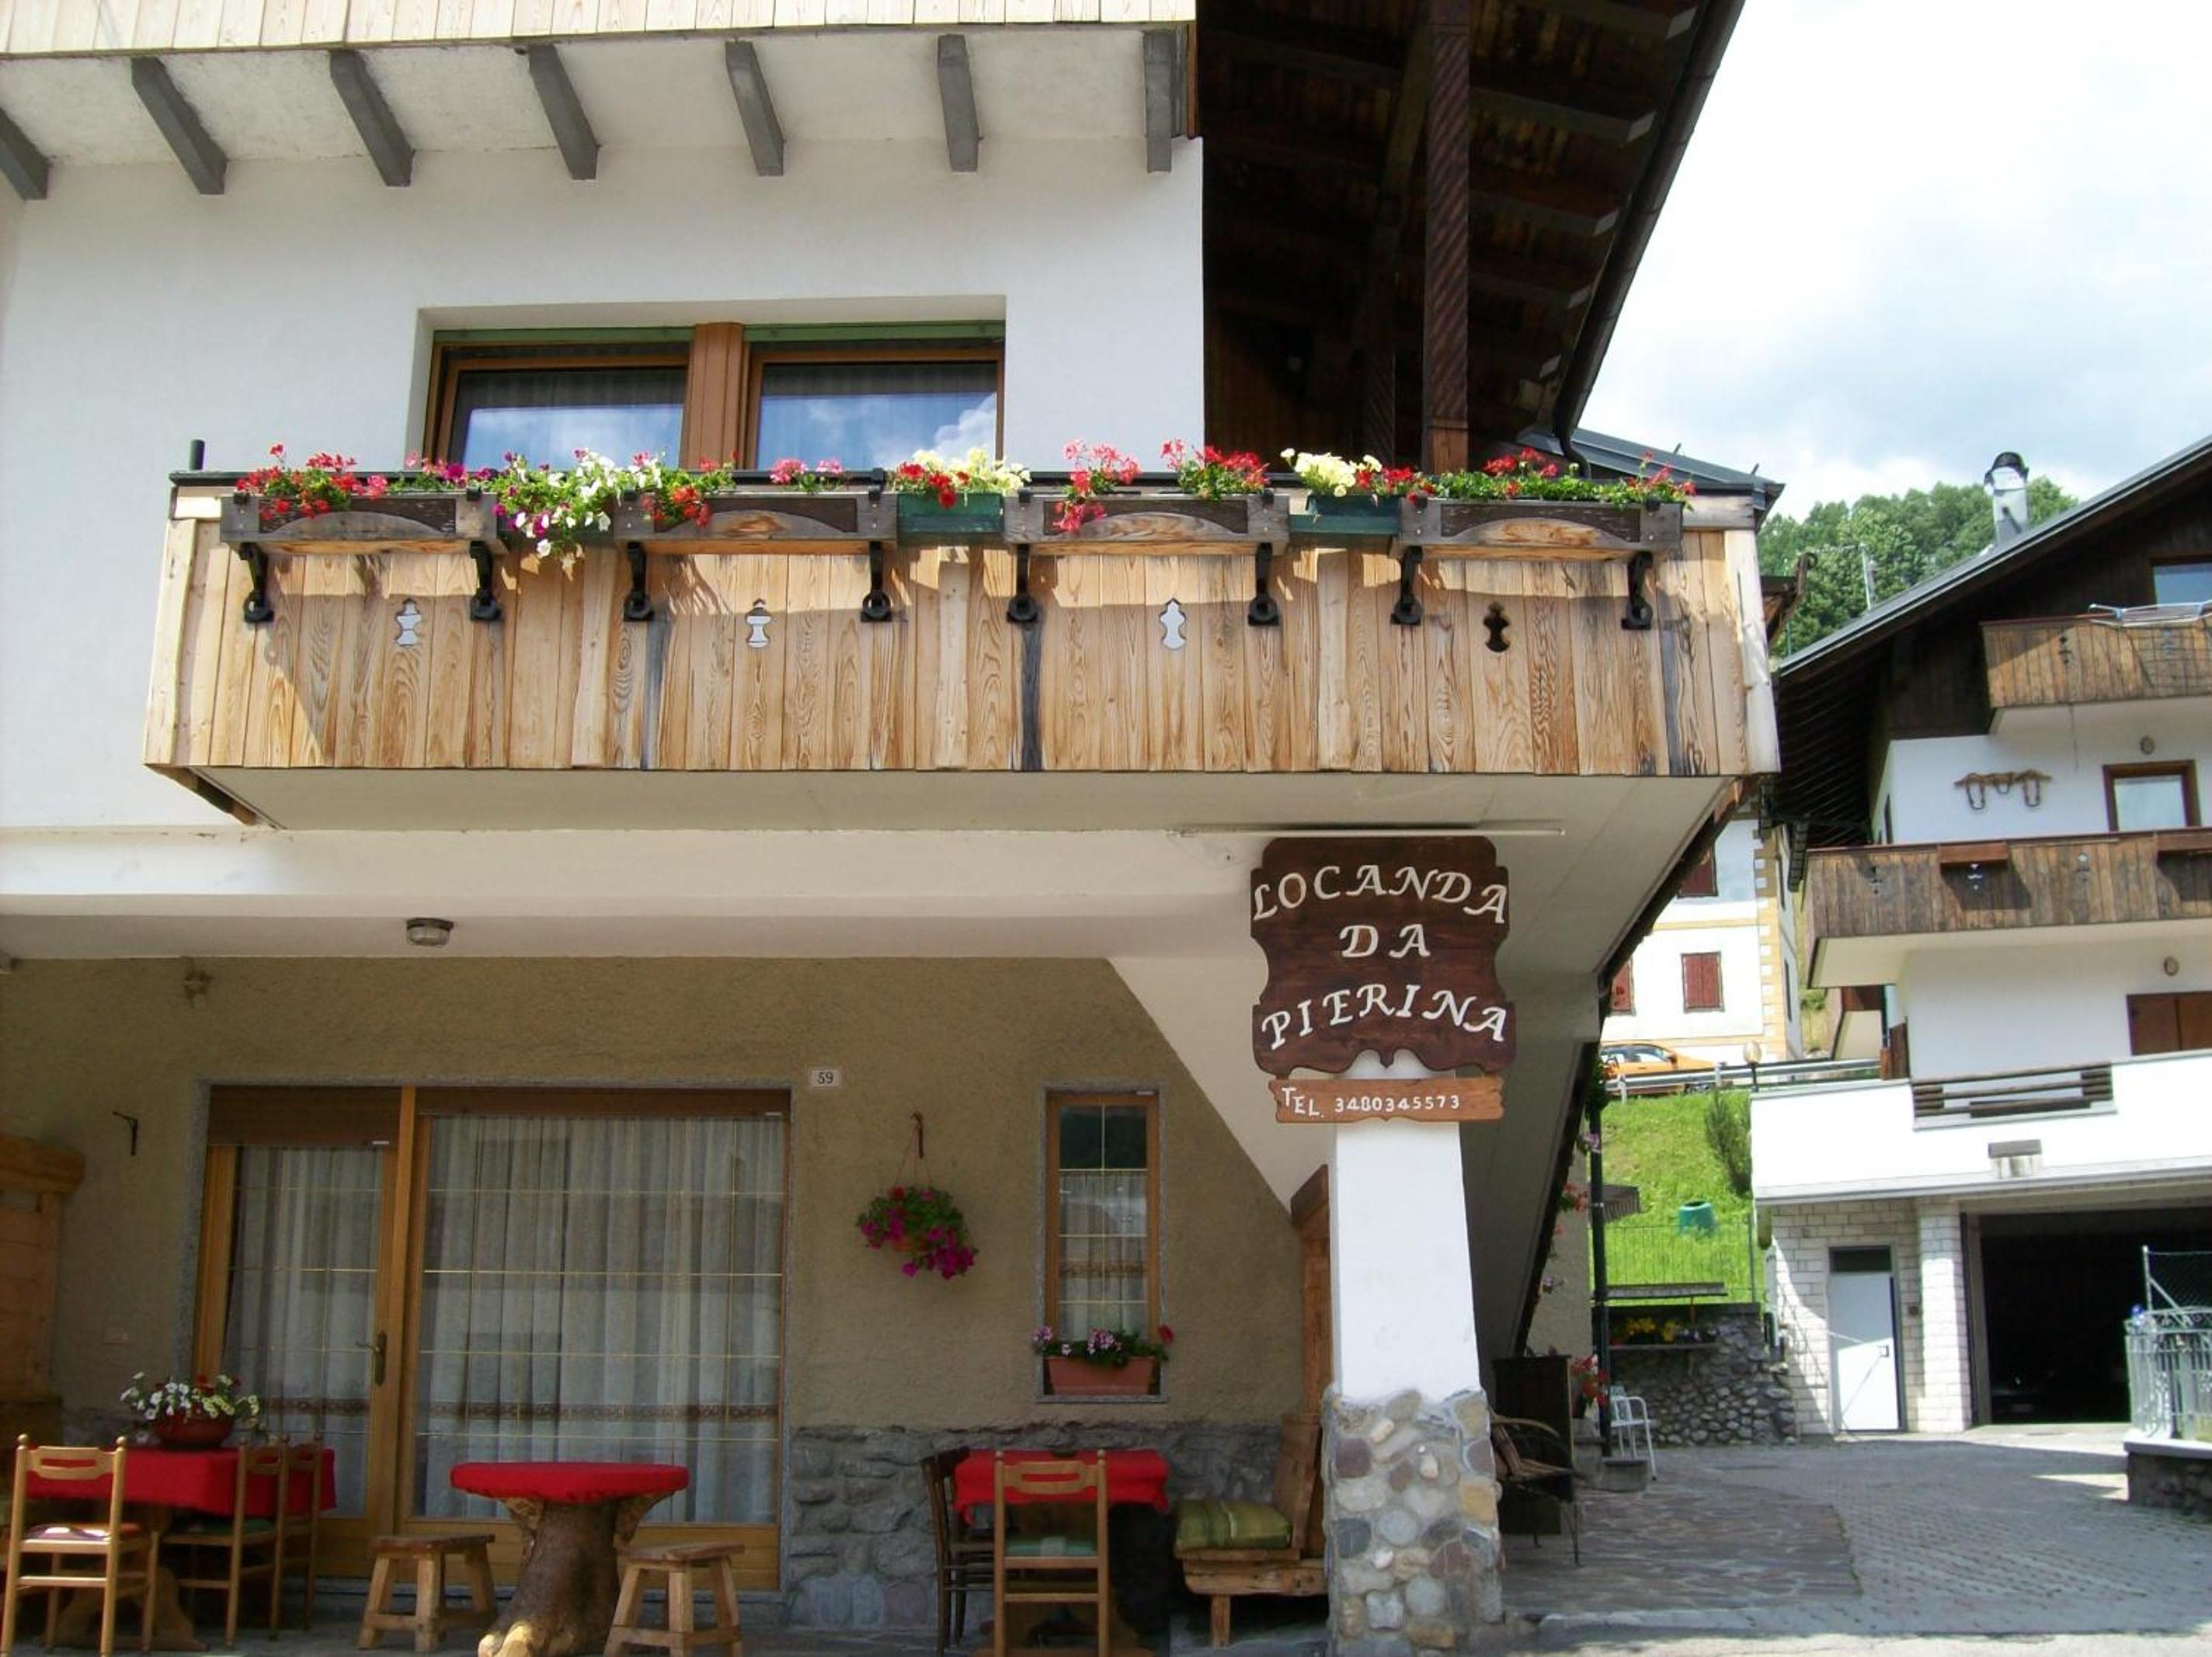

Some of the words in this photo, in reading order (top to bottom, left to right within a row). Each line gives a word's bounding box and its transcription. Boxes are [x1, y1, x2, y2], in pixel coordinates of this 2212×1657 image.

[1253, 864, 1508, 924] LOCANDA
[1339, 924, 1431, 959] DA
[1261, 984, 1508, 1051] PIERINA
[818, 1072, 833, 1084] 59
[1282, 1087, 1325, 1118] TEL.
[1334, 1095, 1460, 1113] 3480345573
